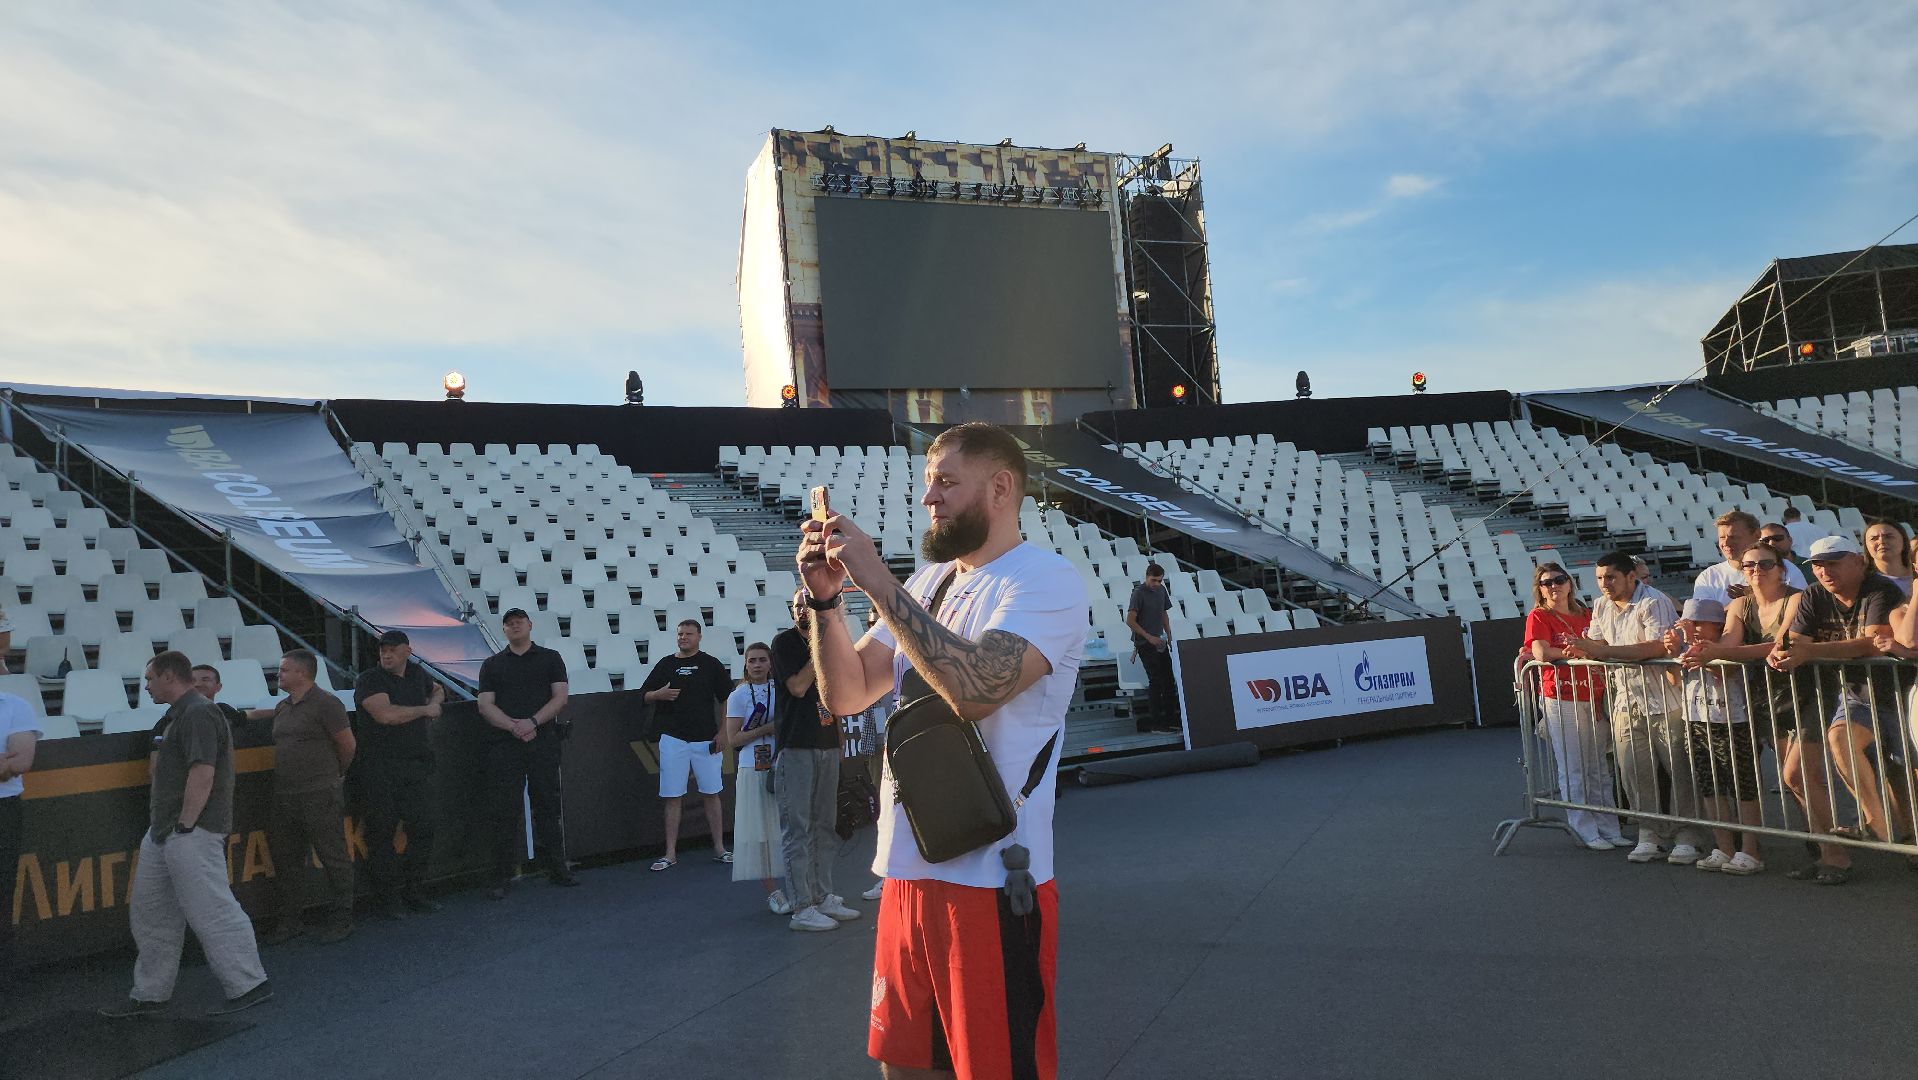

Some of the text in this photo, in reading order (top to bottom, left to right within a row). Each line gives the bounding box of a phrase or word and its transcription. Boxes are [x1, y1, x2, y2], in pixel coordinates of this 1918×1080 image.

[1700, 428, 1918, 486] COLISEUM
[202, 472, 369, 569] COLISEUM
[1056, 468, 1239, 533] COLISEUM
[1284, 673, 1331, 700] IBA
[1372, 671, 1416, 691] ГАЗПРОМ
